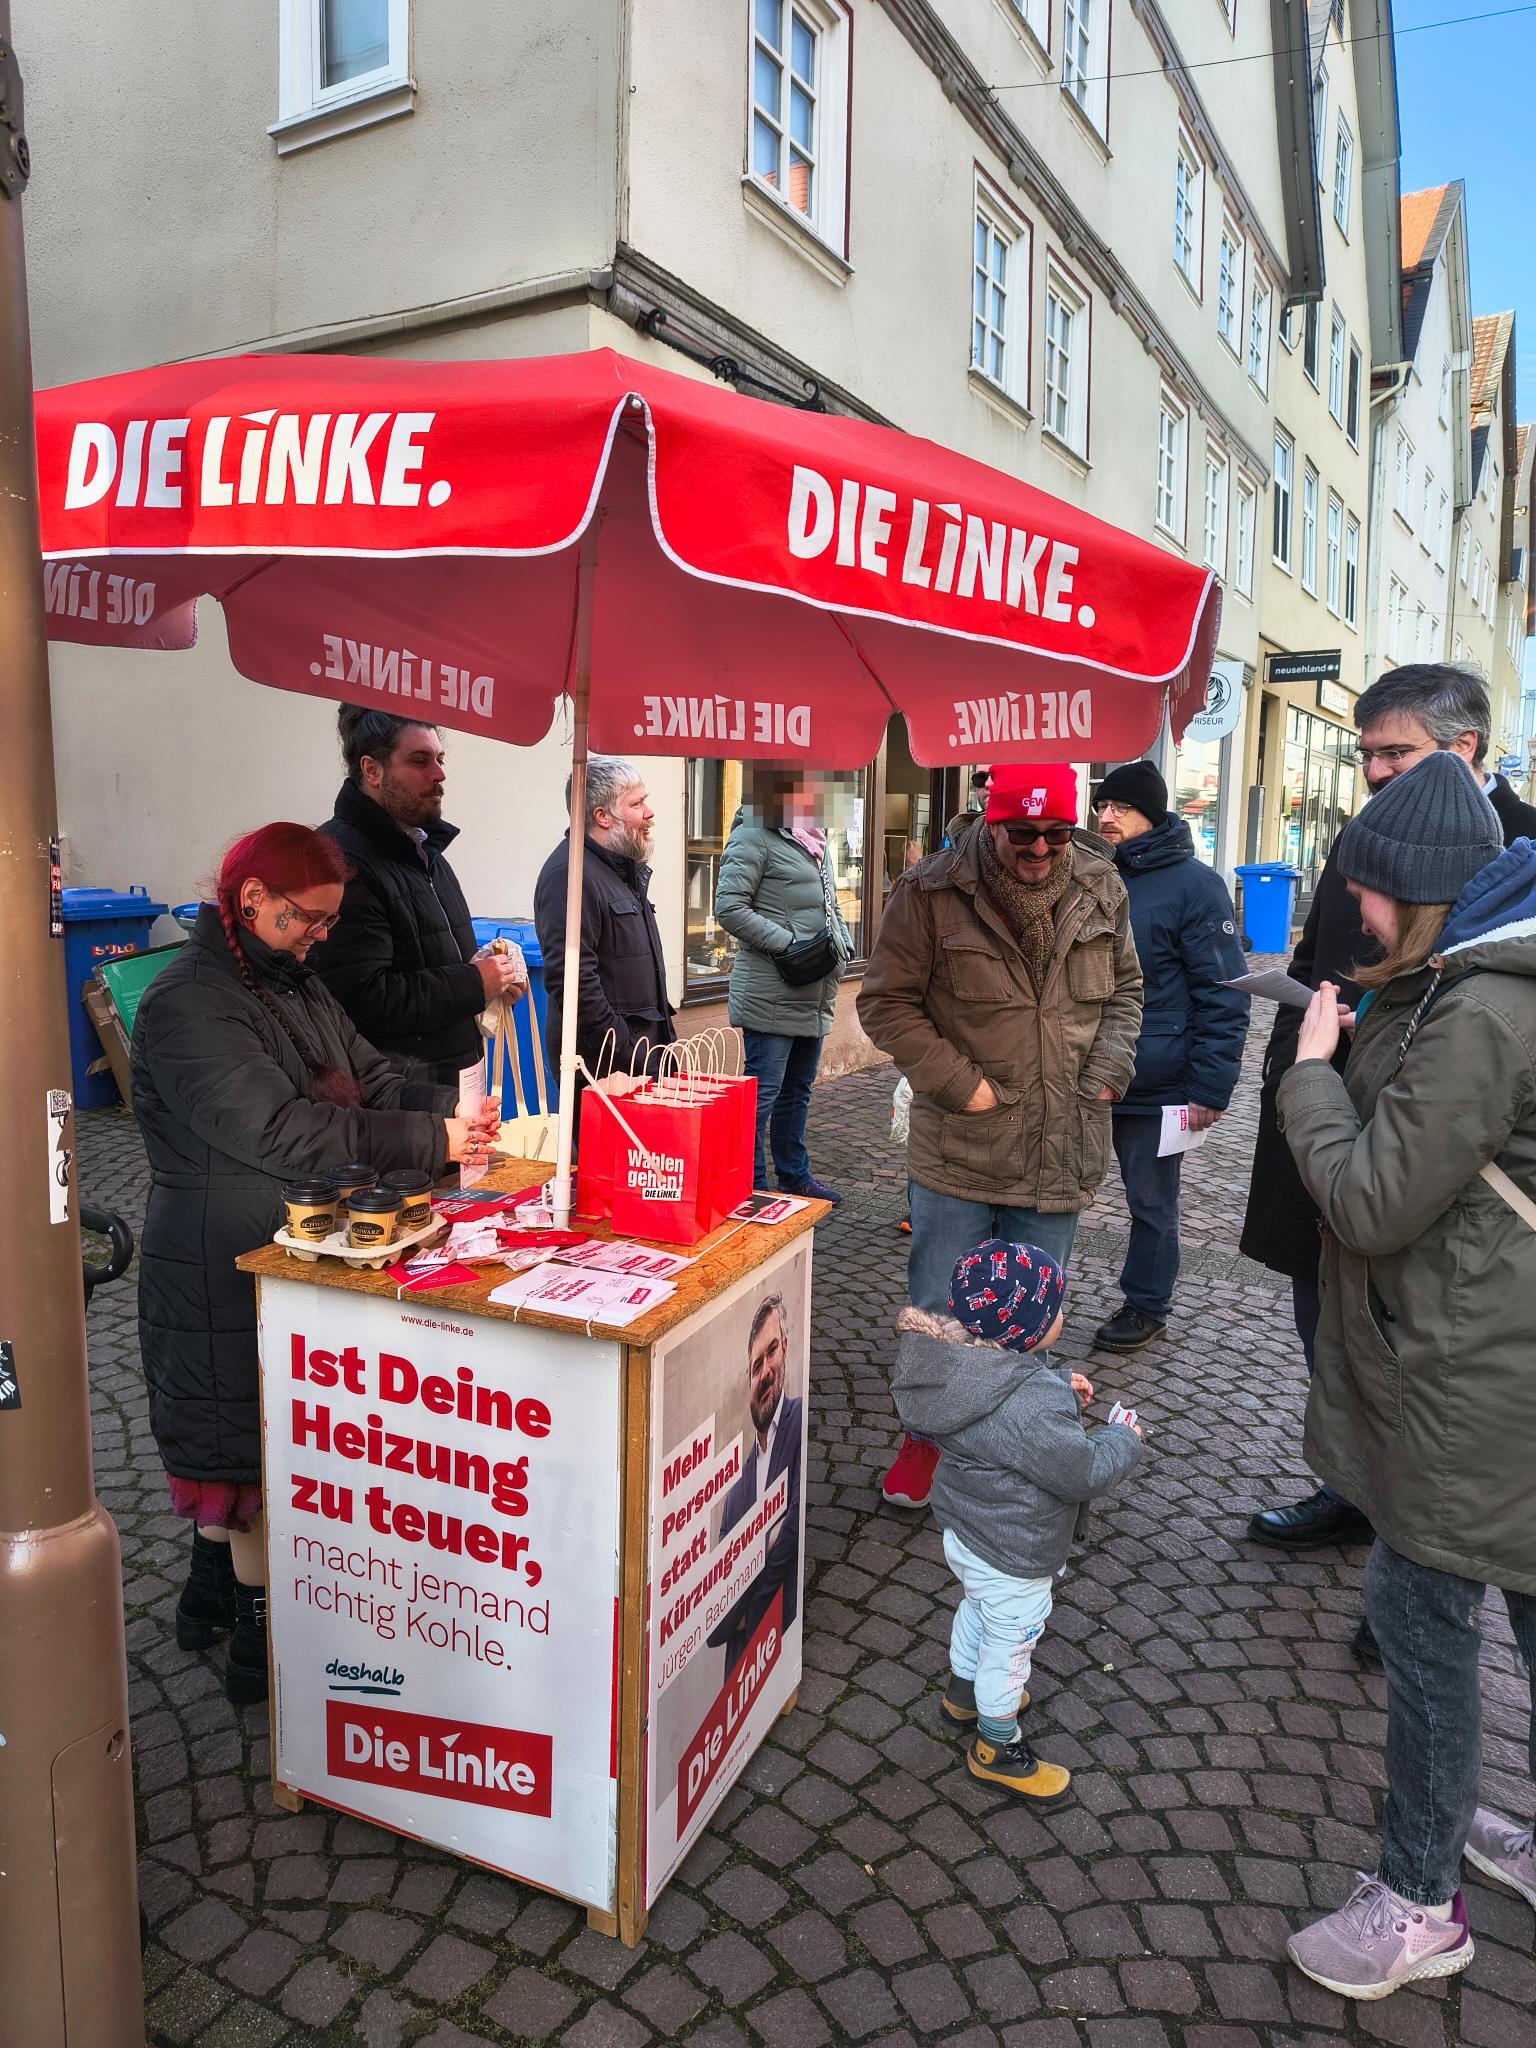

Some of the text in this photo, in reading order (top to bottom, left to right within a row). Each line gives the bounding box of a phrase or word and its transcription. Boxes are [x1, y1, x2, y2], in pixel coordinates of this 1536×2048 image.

[64, 417, 191, 510] DIE
[787, 465, 897, 574] DIE
[1275, 664, 1326, 675] neusehland
[1194, 717, 1224, 725] RISEUR
[1022, 797, 1048, 807] GEW
[627, 1149, 685, 1173] Wahlen
[628, 1170, 684, 1191] gehen!
[645, 1190, 657, 1198] DIE
[401, 1314, 474, 1337] www.die-linke.de
[291, 1333, 551, 1438] Ist Deine
[291, 1399, 529, 1517] Heizung
[662, 1445, 739, 1548] Personal
[663, 1434, 712, 1498] Mehr
[291, 1473, 542, 1588] zu teuer,
[660, 1526, 708, 1597] statt
[660, 1480, 785, 1648] Kürzungswahn!
[294, 1534, 550, 1636] macht jemand
[294, 1574, 512, 1671] richtig Kohle.
[657, 1549, 763, 1690] Jürgen Bachmann
[326, 1658, 405, 1686] deshalb
[688, 1724, 723, 1807] Die
[727, 1626, 777, 1737] Linke
[344, 1723, 536, 1796] Die Linke
